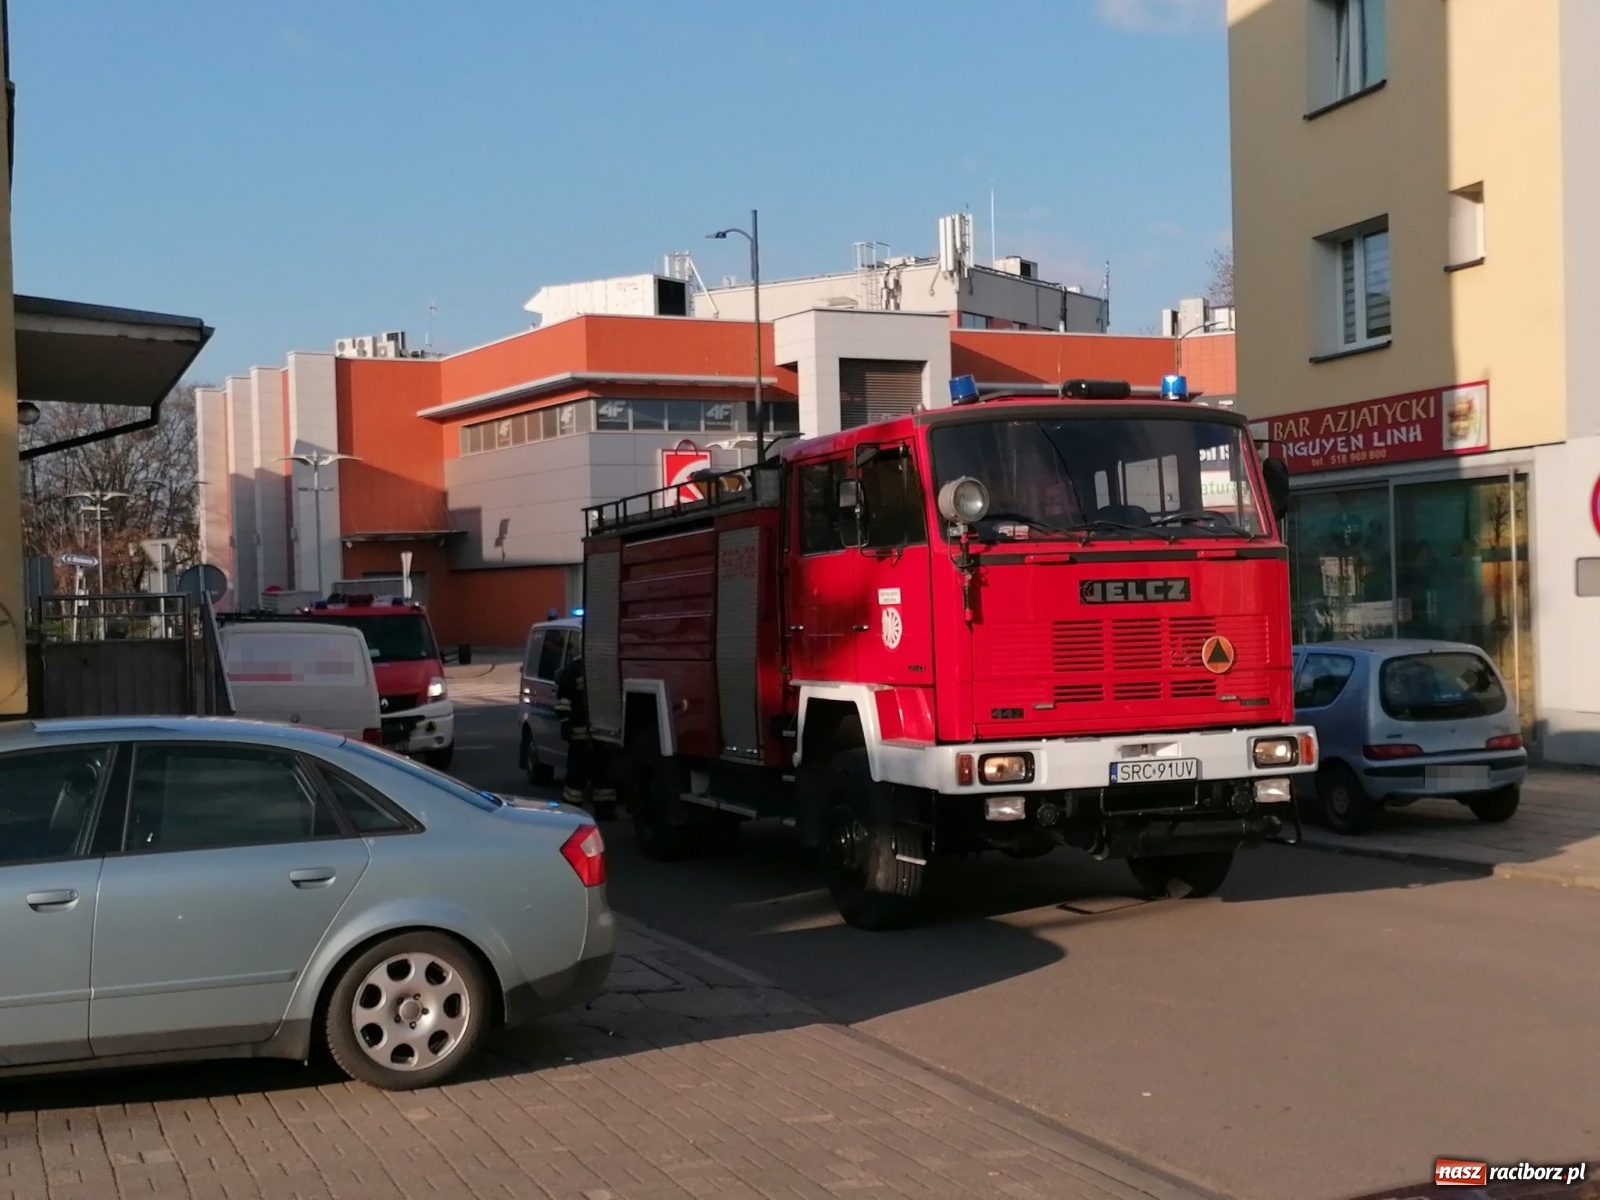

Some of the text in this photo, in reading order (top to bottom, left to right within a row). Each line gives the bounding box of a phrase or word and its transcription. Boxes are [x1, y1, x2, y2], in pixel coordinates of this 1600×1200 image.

[598, 401, 626, 418] 4F
[706, 404, 732, 420] 4F
[1273, 396, 1435, 441] BAR AZJATYCKI
[1282, 424, 1422, 459] NGUYEN LINH
[1084, 580, 1186, 602] JELCZ
